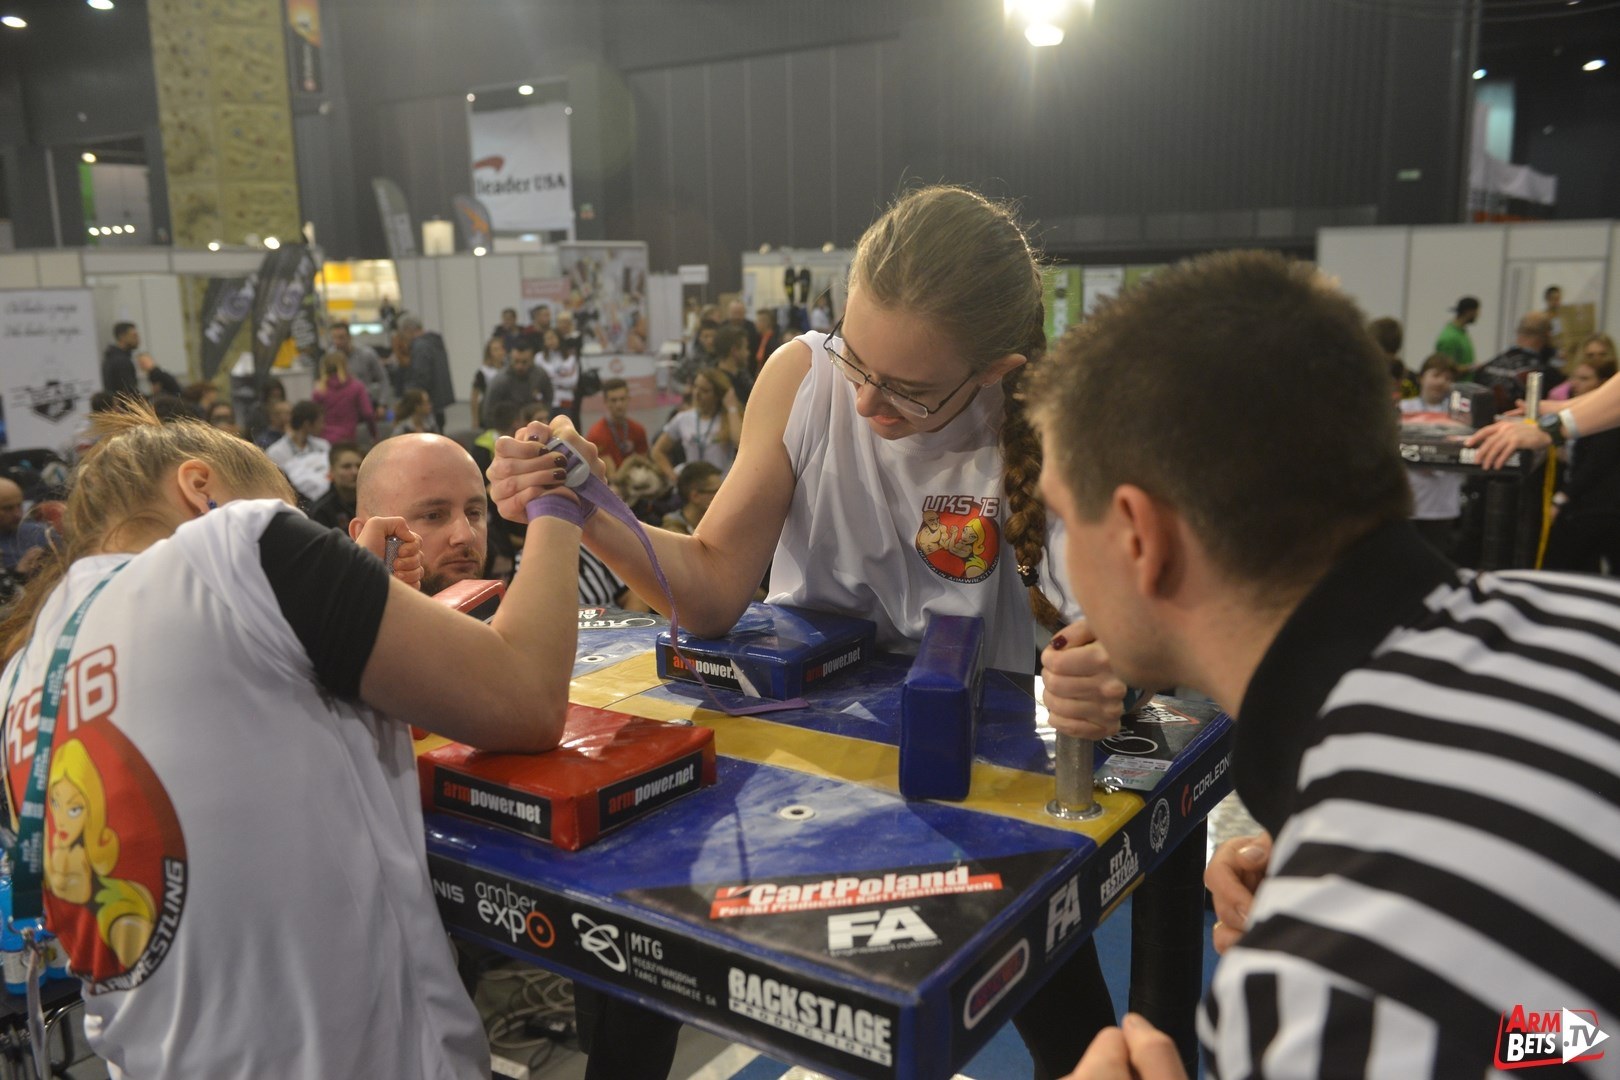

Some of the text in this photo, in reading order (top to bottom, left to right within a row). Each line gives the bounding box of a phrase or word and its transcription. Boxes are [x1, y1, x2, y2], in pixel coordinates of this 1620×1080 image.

[922, 495, 1000, 519] UKS 16
[805, 646, 861, 683] armpower.net
[64, 643, 118, 734] 16
[443, 779, 542, 825] armpower.net
[608, 763, 695, 815] armpower.net
[1101, 851, 1139, 903] FESTIVAL
[1110, 848, 1124, 876] FIT
[474, 880, 537, 912] amber
[748, 865, 969, 906] CartPoland
[477, 899, 556, 949] expo
[828, 906, 938, 951] FA
[1046, 873, 1081, 953] FA
[631, 931, 664, 960] MTG
[728, 966, 892, 1051] BACKSTAGE
[730, 1000, 890, 1065] PRODUCTIONS
